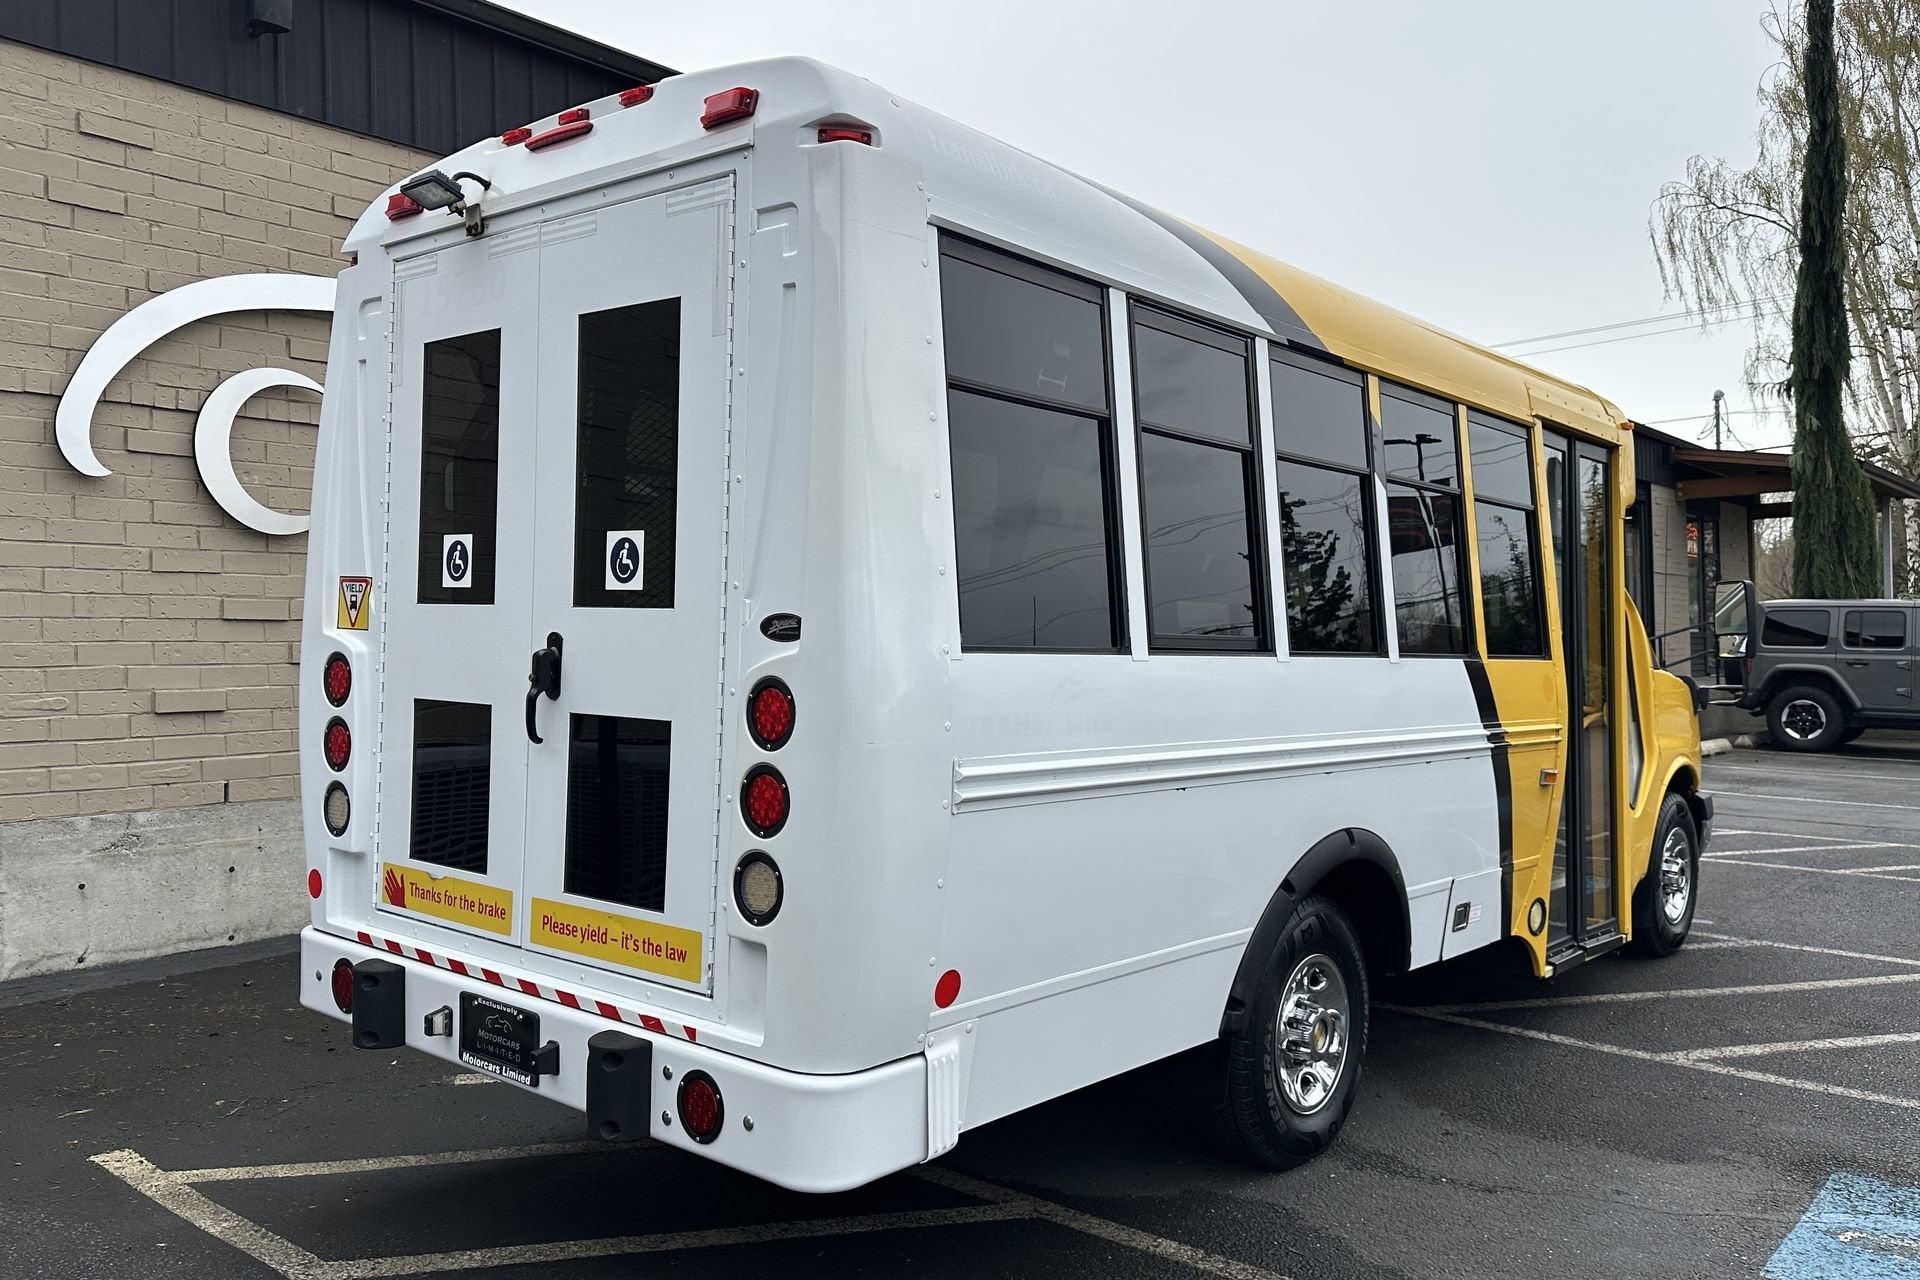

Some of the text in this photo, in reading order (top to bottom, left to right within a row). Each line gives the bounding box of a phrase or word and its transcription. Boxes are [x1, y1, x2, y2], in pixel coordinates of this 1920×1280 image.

[345, 583, 364, 593] YIELD
[409, 882, 507, 920] Thanks for the brake
[542, 914, 578, 938] Please
[580, 924, 608, 944] yield
[621, 931, 640, 953] it’s
[642, 937, 662, 958] the
[665, 941, 688, 963] law
[477, 997, 519, 1016] Exclusively
[477, 1028, 521, 1051] MOTORCARS
[462, 1051, 532, 1086] Motorcars Limited
